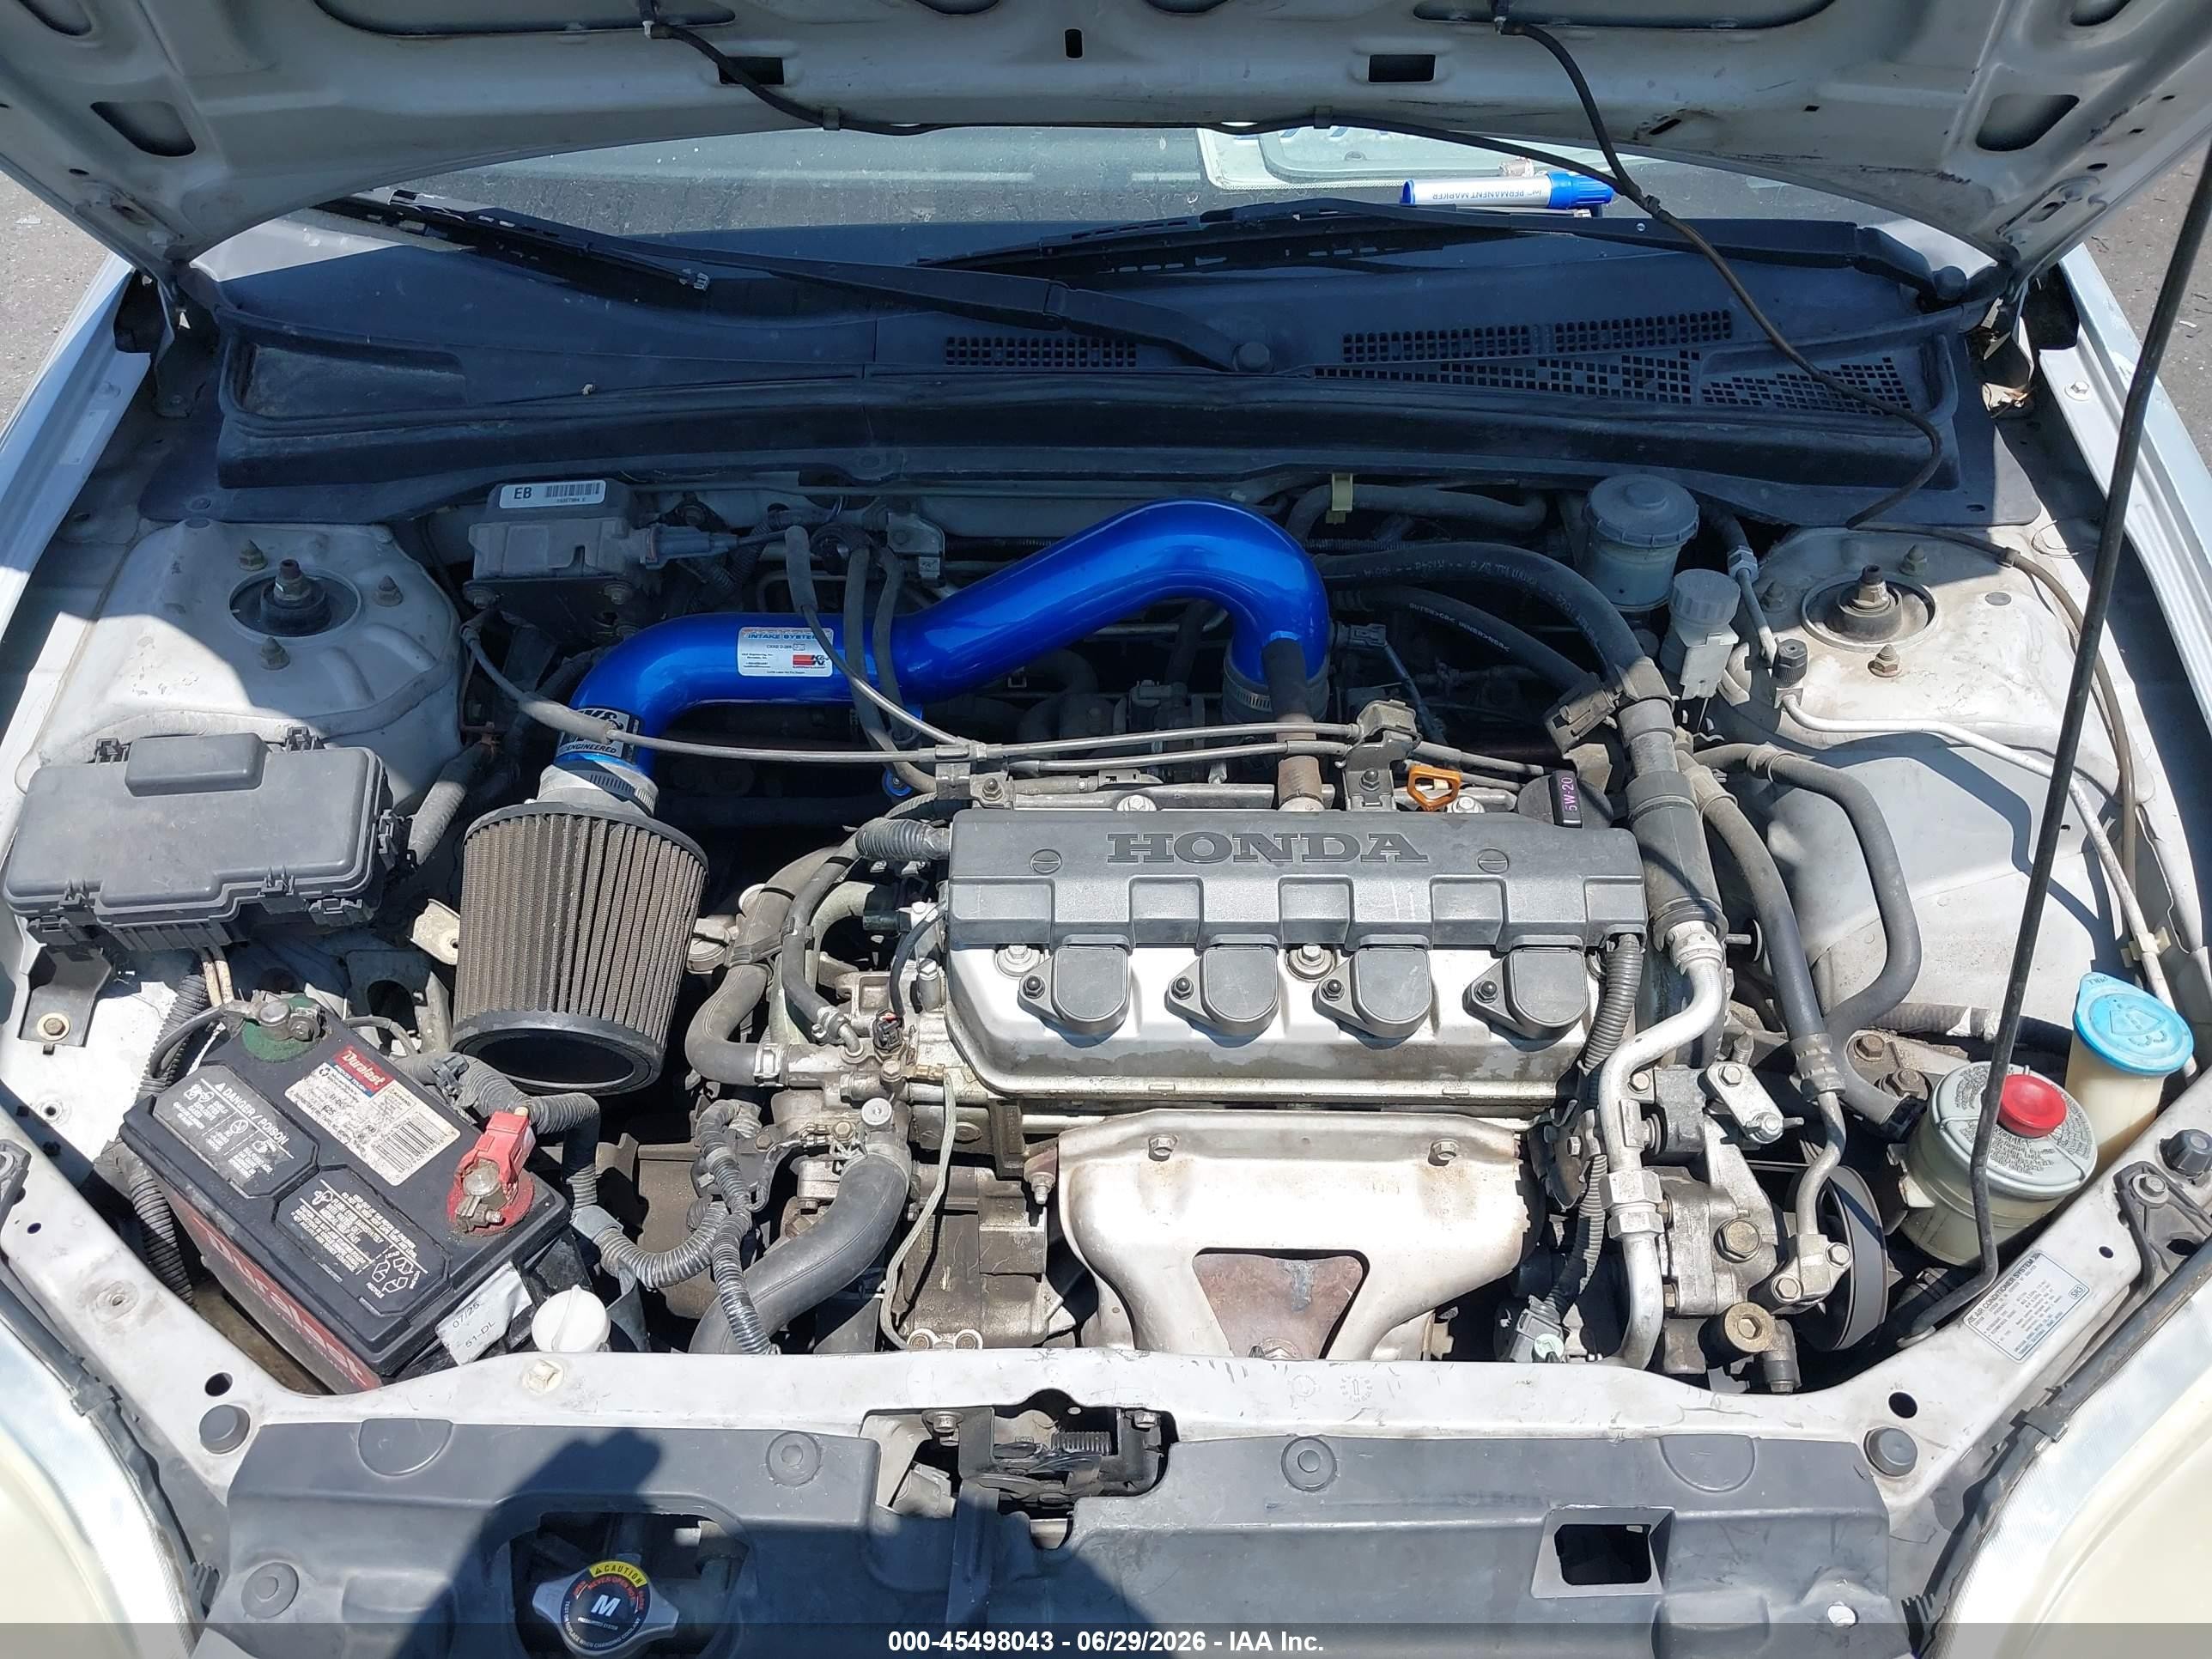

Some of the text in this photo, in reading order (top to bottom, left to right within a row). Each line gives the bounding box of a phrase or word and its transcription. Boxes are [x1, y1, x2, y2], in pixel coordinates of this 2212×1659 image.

[514, 487, 532, 499] EB
[568, 744, 617, 753] ENGINEERED
[1561, 777, 1577, 811] 5W-20
[1107, 831, 1429, 865] HONDA
[342, 1049, 386, 1085] Duralast
[222, 1088, 256, 1117] DANGER
[258, 1117, 290, 1146] POISON
[319, 1208, 361, 1243] MEDICAL HELP FAST
[326, 1203, 338, 1214] WITH
[350, 1224, 362, 1235] GET
[331, 1198, 384, 1243] FLUSH EYES IMMEDIATELY
[366, 1282, 385, 1299] RECYCLE
[1975, 1259, 2033, 1316] AIR CONDITIONER SYSTEM
[206, 1231, 364, 1378] Duralast
[453, 1302, 480, 1328] 07/25
[465, 1322, 495, 1347] 51-DL
[604, 1565, 642, 1584] CAUTION
[591, 1595, 621, 1617] M
[565, 1621, 579, 1643] REPLACE
[579, 1639, 595, 1648] WHEN
[594, 1638, 622, 1648] CHANGING
